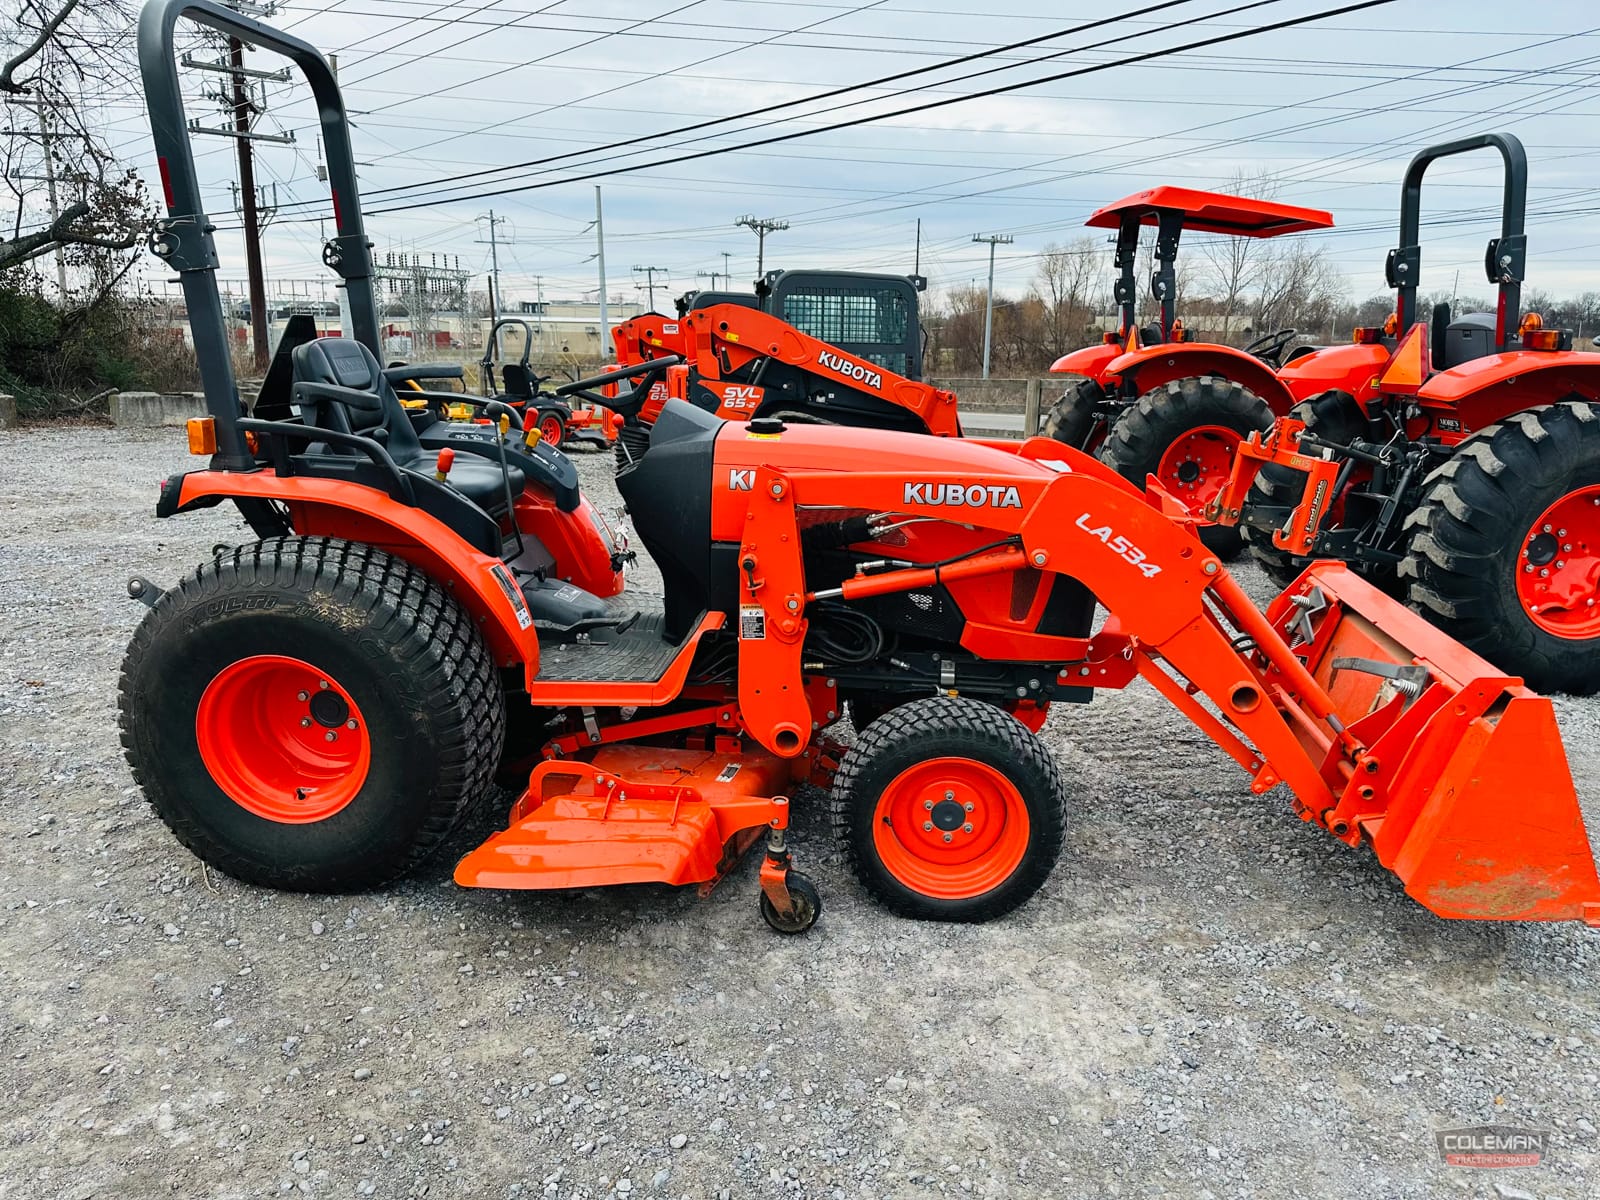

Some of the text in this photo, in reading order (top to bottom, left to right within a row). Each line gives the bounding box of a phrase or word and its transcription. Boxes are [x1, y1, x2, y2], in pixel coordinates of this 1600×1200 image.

[818, 350, 882, 389] KUBOTA
[722, 386, 760, 398] SVL
[903, 482, 1022, 508] KUBOTA
[1075, 512, 1162, 577] LA534
